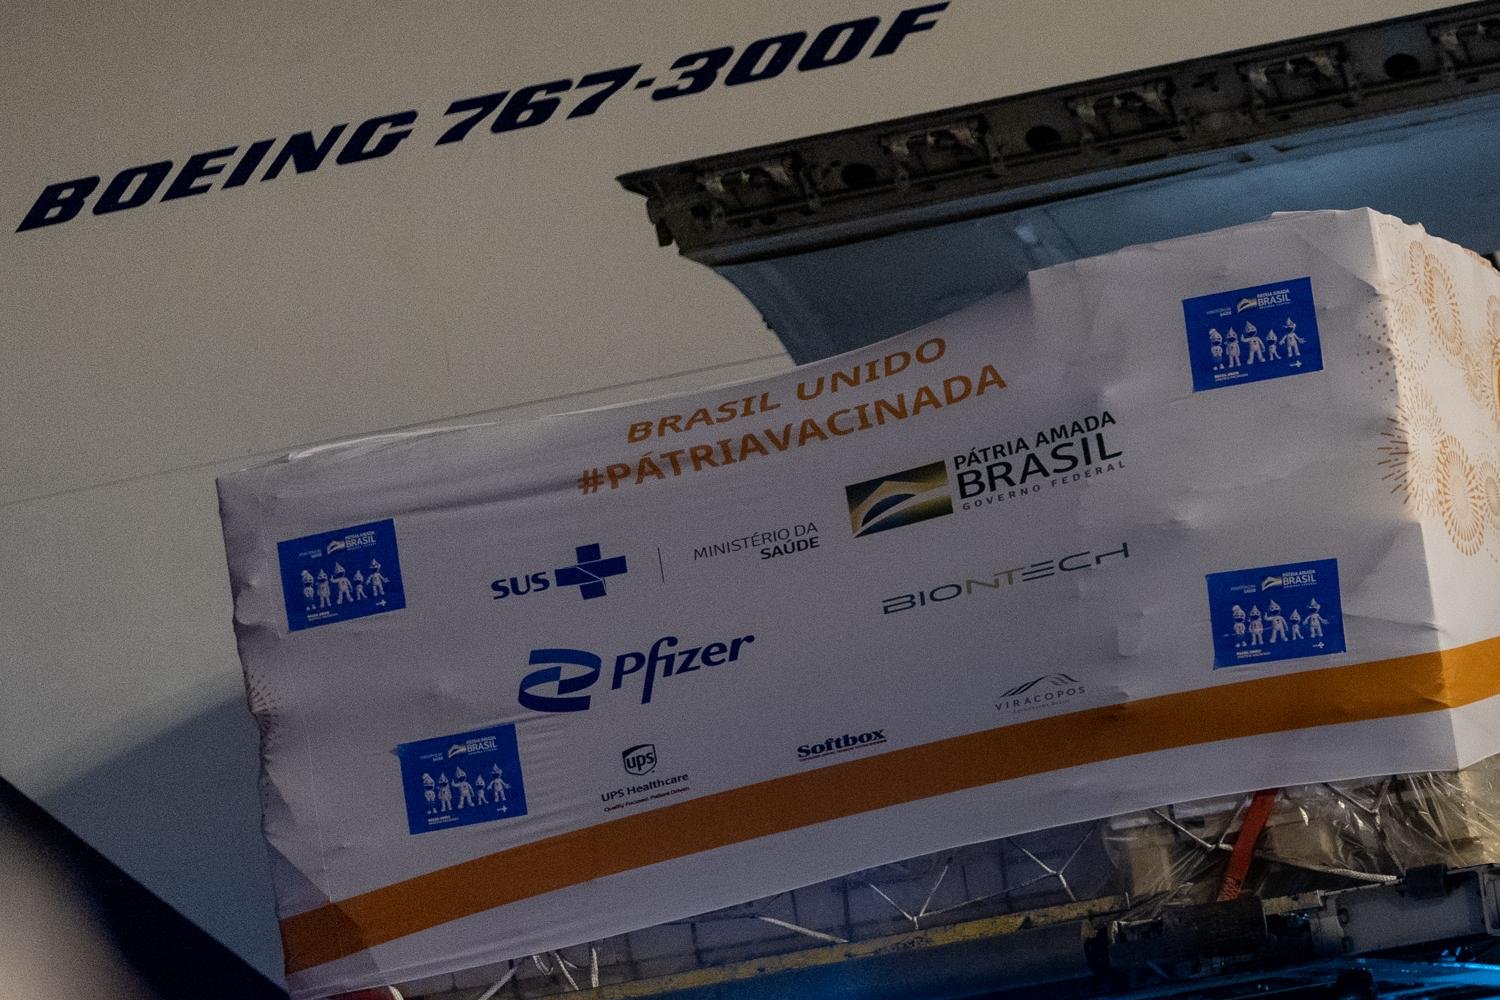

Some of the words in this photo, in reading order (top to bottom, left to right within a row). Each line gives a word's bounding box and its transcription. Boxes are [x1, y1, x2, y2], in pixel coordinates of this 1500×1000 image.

[16, 110, 418, 233] BOEING
[435, 1, 951, 147] 767-300F
[1258, 294, 1291, 307] BRASIL
[627, 390, 782, 443] BRASIL
[796, 337, 947, 402] UNIDO
[577, 363, 1007, 495] #PÁTRIAVACINADA
[954, 437, 1031, 470] PÁTRIA
[1035, 410, 1117, 448] AMADA
[956, 432, 1124, 500] BRASIL
[962, 483, 1042, 510] GOVERNO
[1051, 460, 1126, 491] FEDERAL
[346, 534, 377, 548] BRASIL
[693, 526, 791, 561] MINISTÉRIO
[794, 522, 819, 539] DA
[759, 535, 821, 560] SAÚDE
[490, 570, 550, 600] SUS
[882, 541, 1130, 614] BIONTECH
[1283, 574, 1317, 586] BRASIL
[611, 634, 756, 704] Pfizer
[995, 686, 1085, 711] VIRACOPOS
[466, 740, 498, 753] BRASIL
[797, 729, 886, 757] Softbox
[626, 752, 655, 771] ups
[601, 789, 625, 802] UPS
[627, 774, 689, 795] Healthcare
